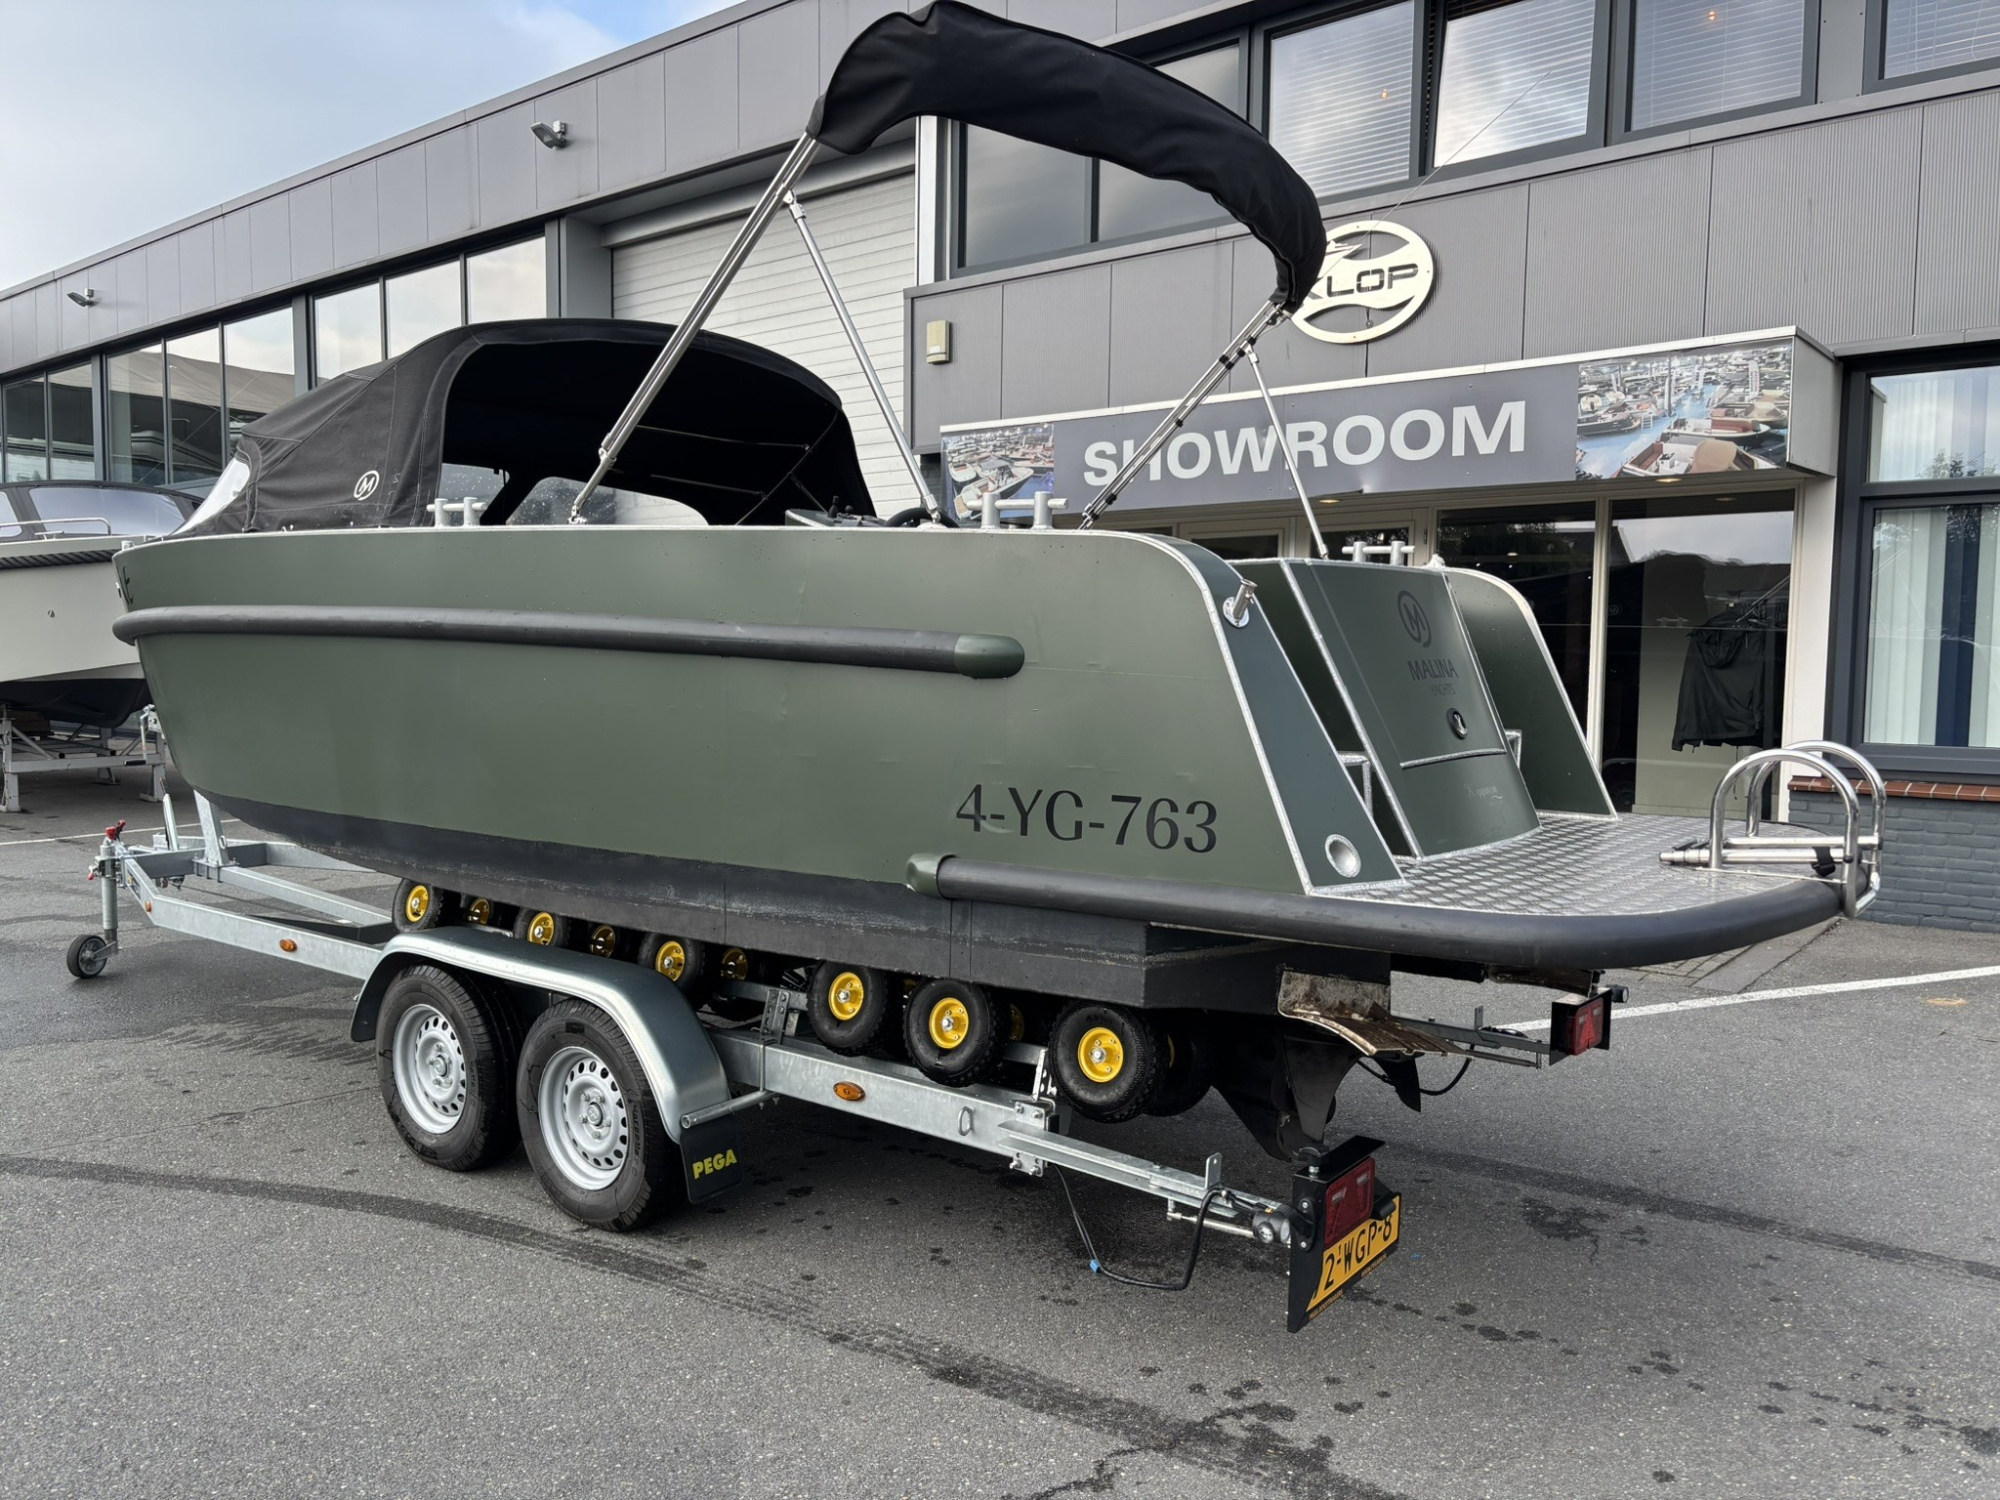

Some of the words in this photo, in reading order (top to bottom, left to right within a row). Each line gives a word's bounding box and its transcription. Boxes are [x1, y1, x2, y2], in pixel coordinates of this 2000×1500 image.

[1308, 263, 1419, 300] LOP
[1083, 400, 1527, 487] SHOWROOM
[1407, 659, 1459, 681] MALINA
[1429, 683, 1456, 696] YACHTS
[956, 784, 1217, 853] 4-YG-763
[692, 1149, 738, 1180] PEGA
